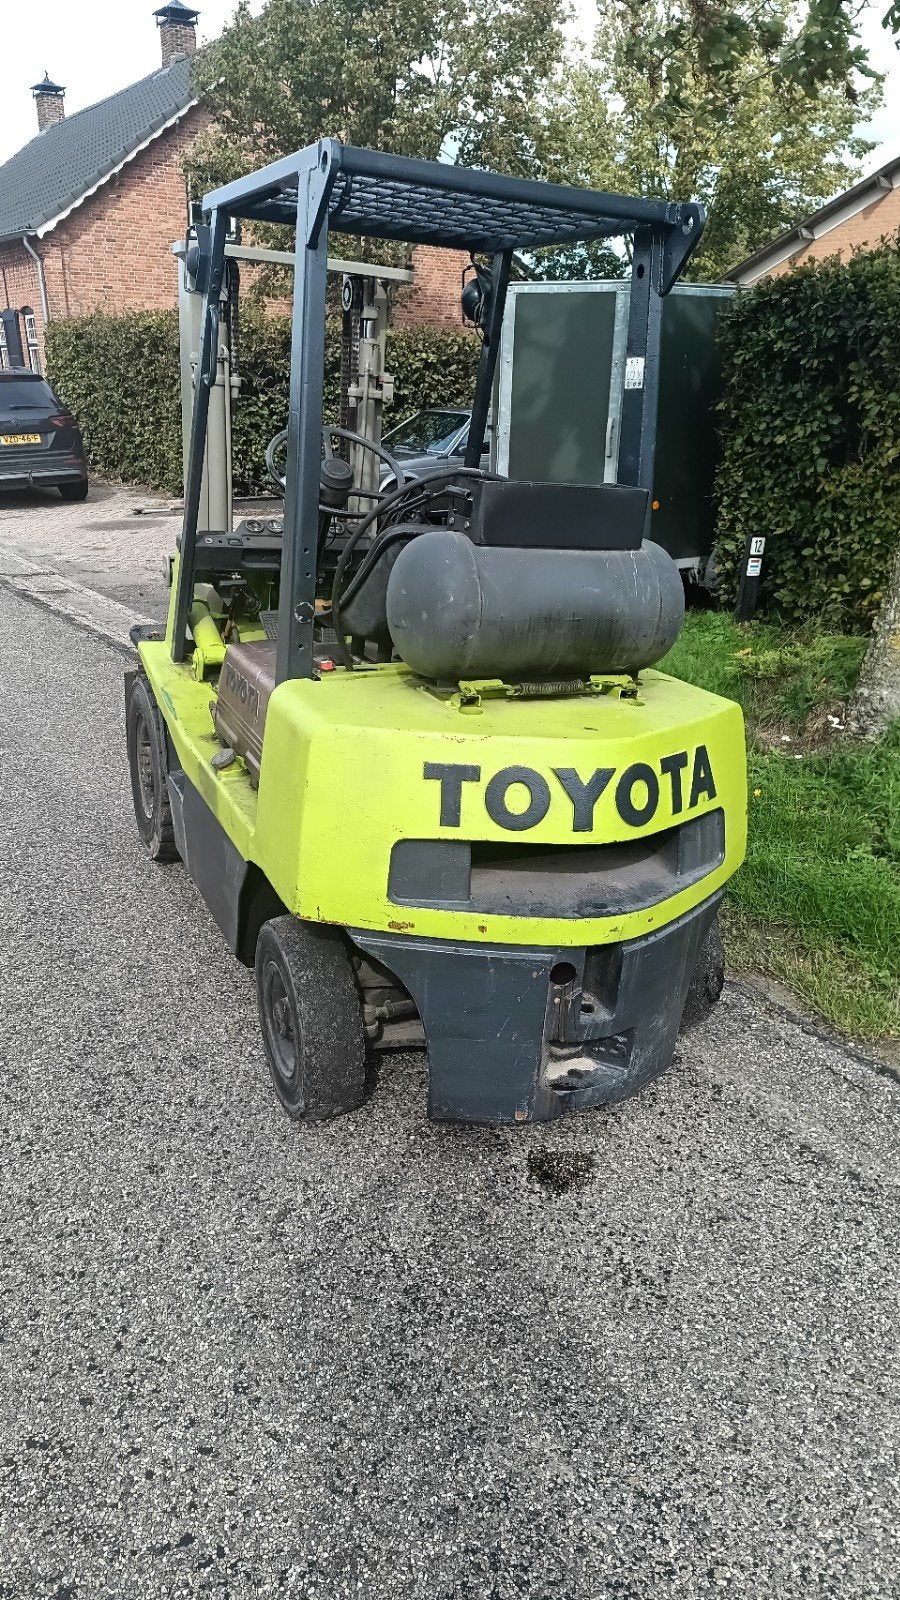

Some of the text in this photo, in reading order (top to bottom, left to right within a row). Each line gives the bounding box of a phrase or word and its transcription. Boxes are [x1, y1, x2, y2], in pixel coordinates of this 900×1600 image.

[755, 539, 763, 553] 12
[226, 662, 260, 717] TOYOTA
[423, 744, 717, 832] TOYOTA
